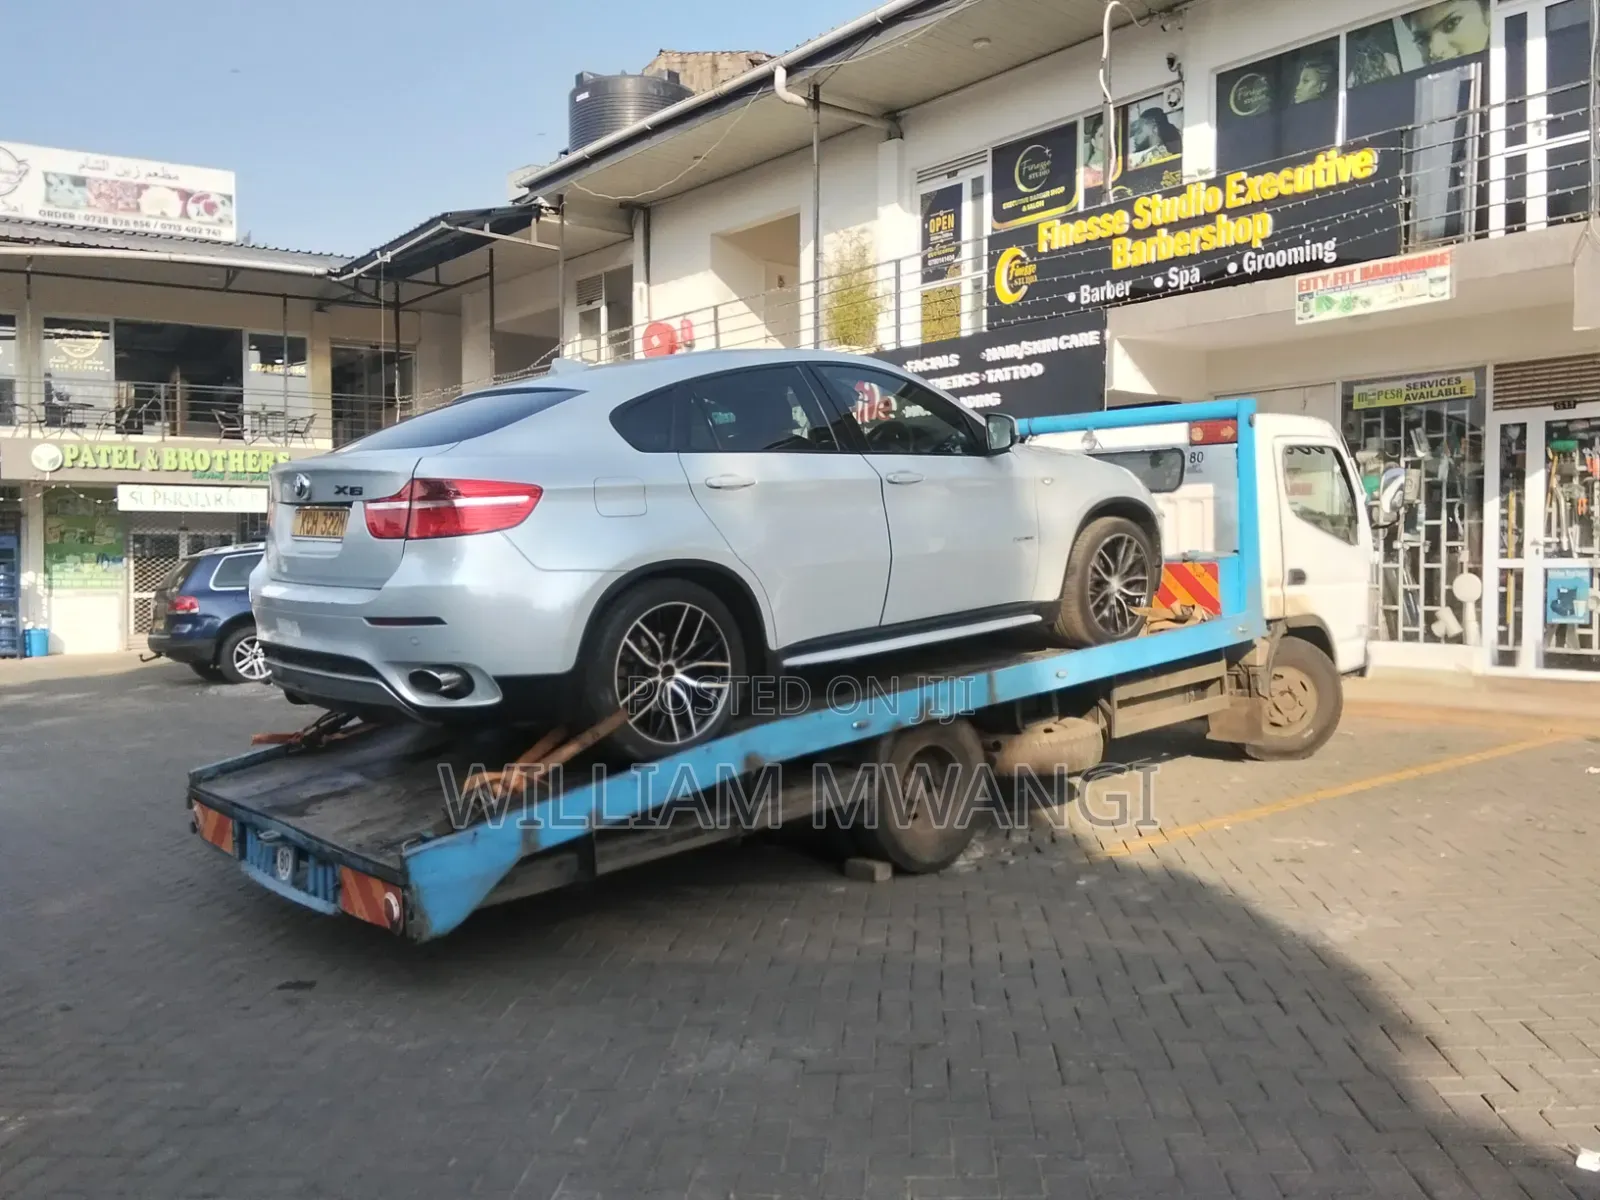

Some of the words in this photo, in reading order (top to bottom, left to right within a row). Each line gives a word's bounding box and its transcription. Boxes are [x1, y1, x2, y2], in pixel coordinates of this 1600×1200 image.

[1021, 158, 1053, 176] Finesse
[1028, 168, 1051, 180] STUDIO
[1037, 209, 1130, 253] Finesse
[1131, 182, 1224, 230] Studio
[1225, 147, 1379, 209] Executive
[38, 209, 76, 220] ORDER
[929, 213, 955, 233] OPEN
[1112, 211, 1273, 271] Barbershop
[1242, 237, 1338, 274] Grooming
[1009, 260, 1037, 281] Finesse
[1168, 266, 1201, 291] Spa
[1080, 280, 1133, 305] Barber
[985, 337, 1059, 362] HAIR/SKIN
[1058, 330, 1101, 351] CARE
[906, 353, 961, 373] FACIALS
[985, 362, 1045, 383] TATTOO
[1403, 385, 1467, 402] AVAILABLE
[1405, 375, 1462, 392] SERVICES
[63, 443, 142, 470] PATEL
[144, 446, 159, 471] &
[161, 447, 291, 473] BROTHERS
[1189, 451, 1204, 463] 80
[128, 488, 258, 508] SUPERMARKT
[333, 485, 364, 496] X6
[279, 851, 291, 870] 80
